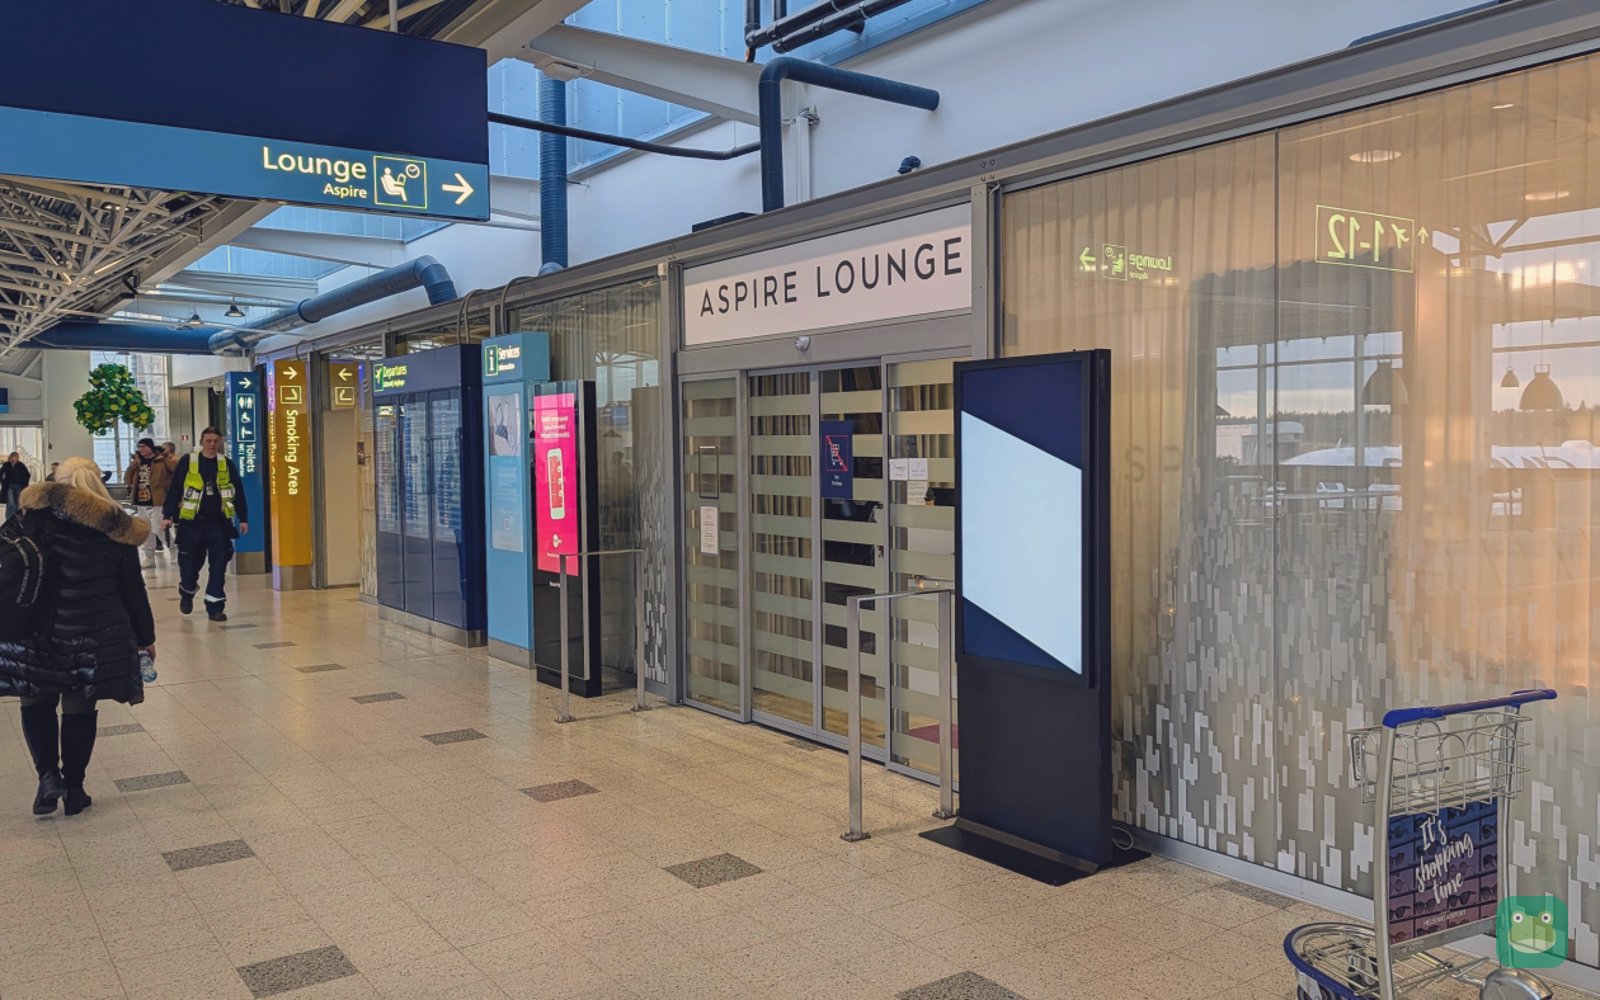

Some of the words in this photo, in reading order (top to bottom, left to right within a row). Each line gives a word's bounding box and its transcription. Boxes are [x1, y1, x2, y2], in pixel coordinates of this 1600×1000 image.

[263, 146, 367, 183] Lounge
[323, 183, 367, 198] Aspire
[700, 271, 797, 317] ASPIRE
[817, 236, 962, 298] LOUNGE
[285, 409, 300, 463] Smoking
[245, 443, 256, 473] Toilets
[287, 465, 300, 495] Area
[1420, 815, 1447, 850] It's
[1415, 832, 1474, 893] shopping
[1432, 872, 1464, 904] time
